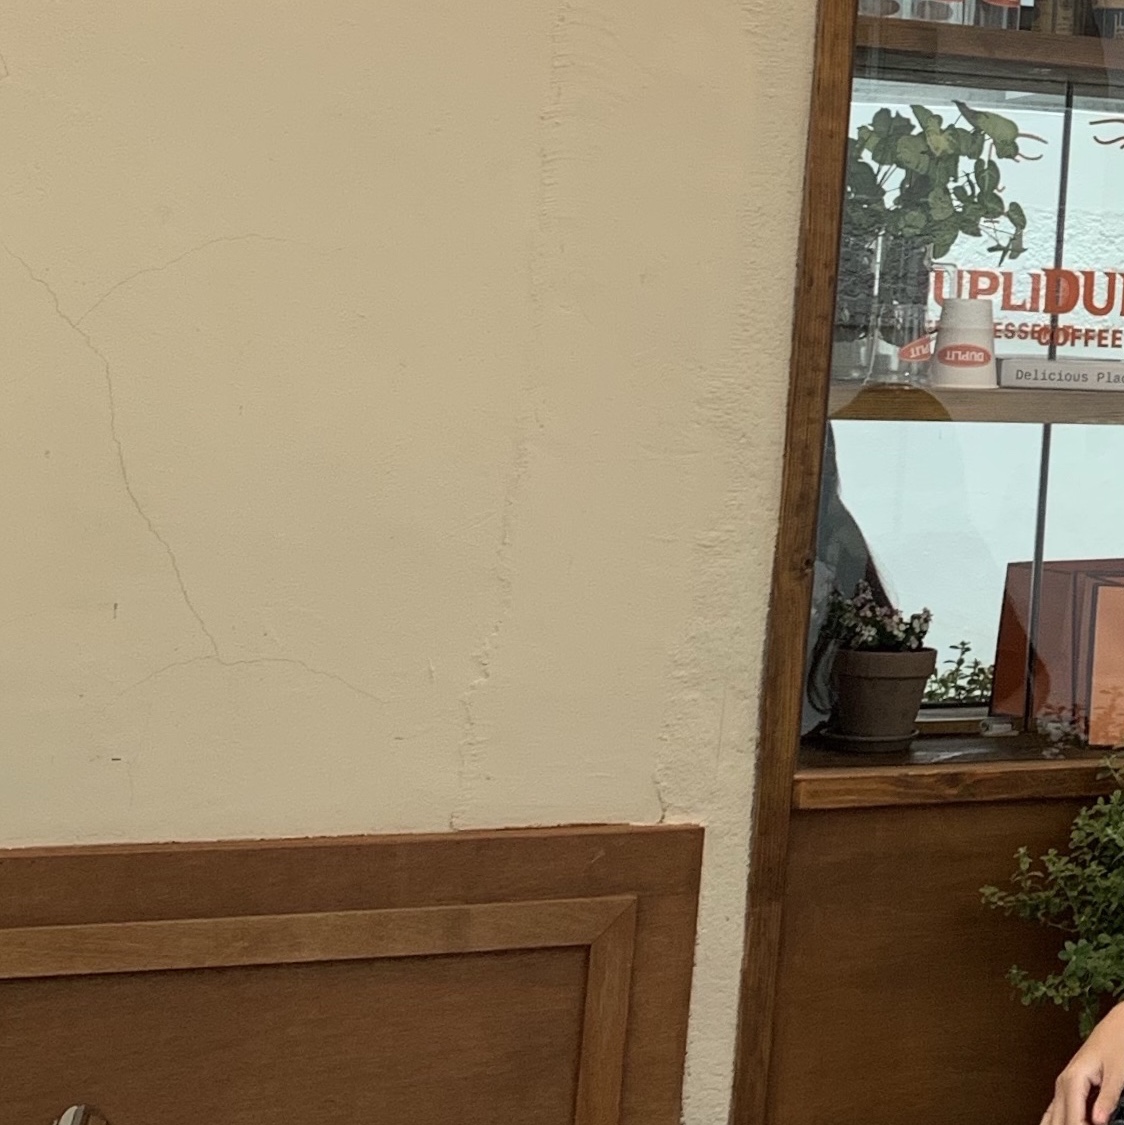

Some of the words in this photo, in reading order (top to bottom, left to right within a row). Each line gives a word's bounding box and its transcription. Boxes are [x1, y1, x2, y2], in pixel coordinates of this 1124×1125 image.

[1037, 326, 1123, 348] COFFEE
[945, 350, 985, 362] DUPLIT
[1015, 369, 1089, 383] Delicious
